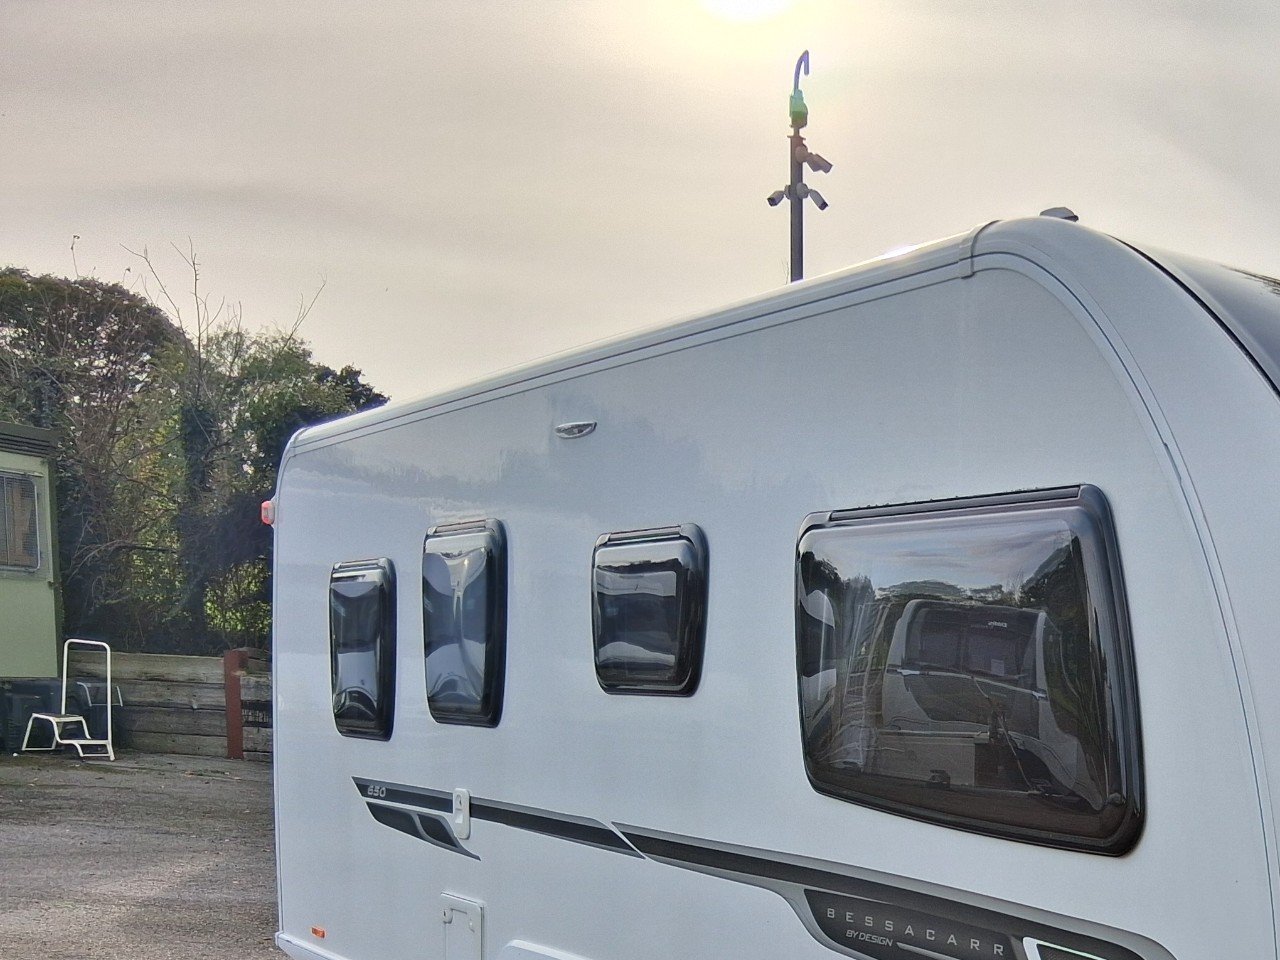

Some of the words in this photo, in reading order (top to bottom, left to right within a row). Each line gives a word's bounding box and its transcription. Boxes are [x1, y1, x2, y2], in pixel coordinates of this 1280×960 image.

[827, 907, 1004, 956] BESSACARR
[845, 930, 859, 939] BY
[859, 932, 893, 947] DESIGN
